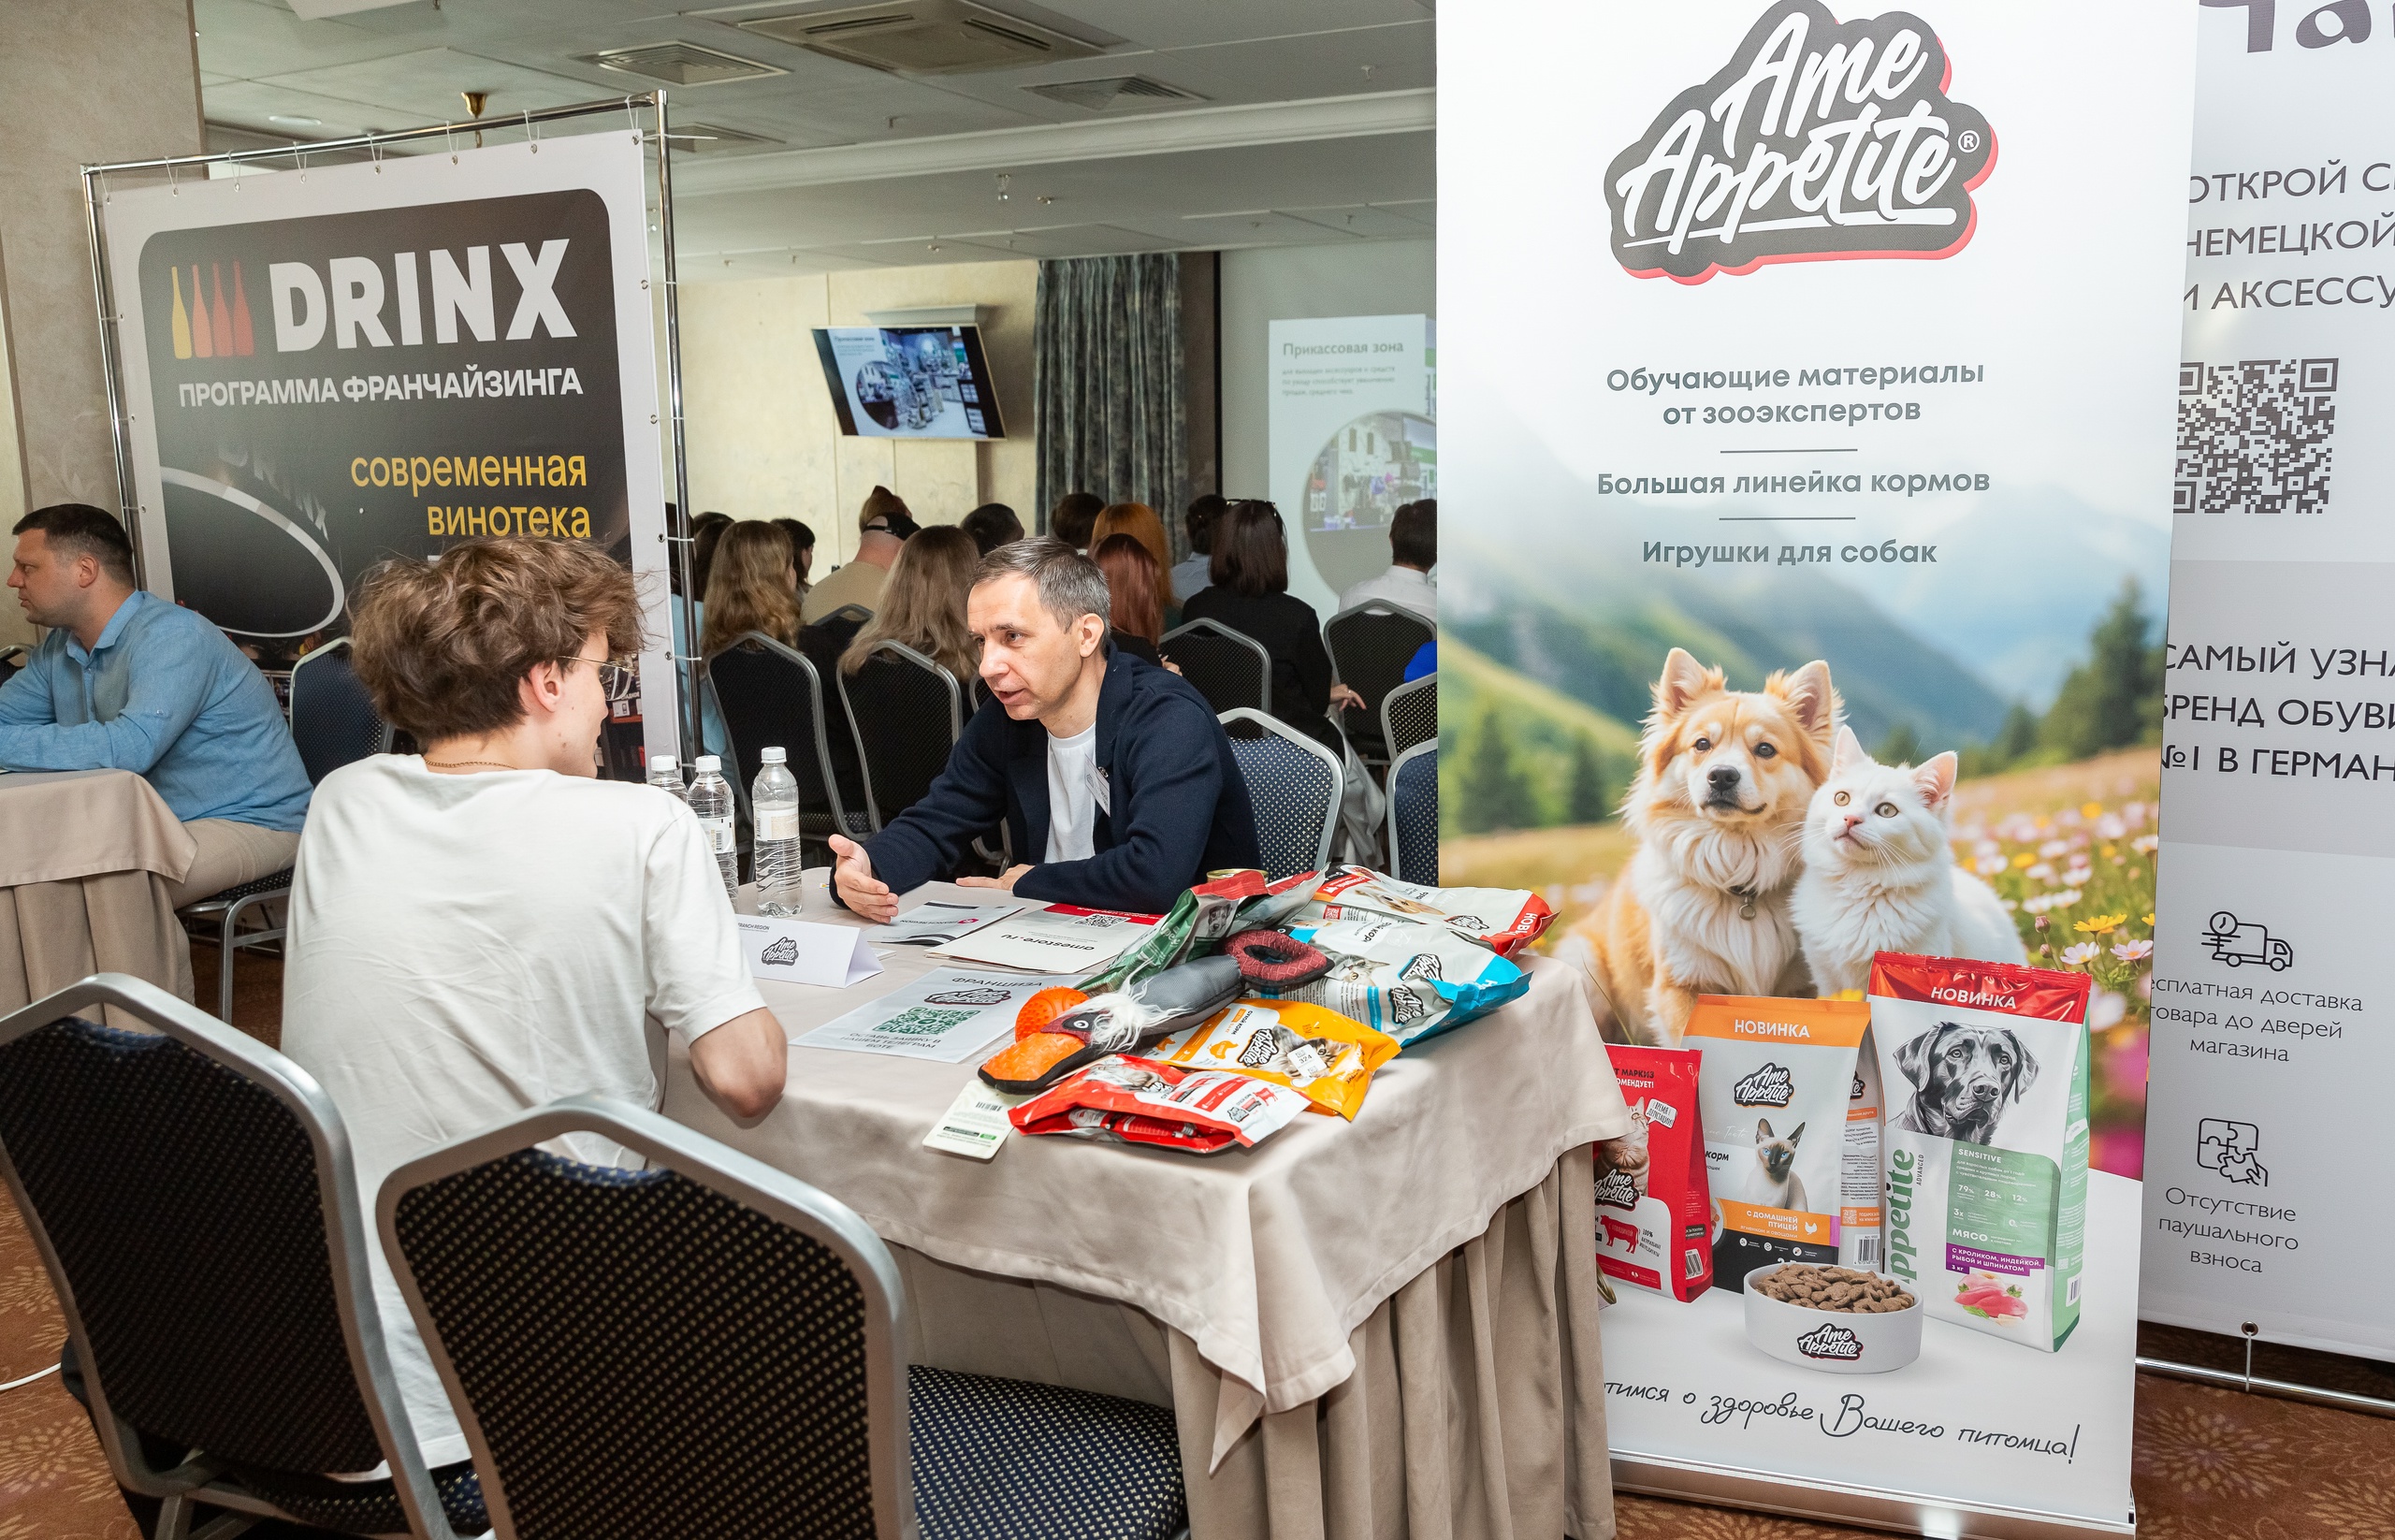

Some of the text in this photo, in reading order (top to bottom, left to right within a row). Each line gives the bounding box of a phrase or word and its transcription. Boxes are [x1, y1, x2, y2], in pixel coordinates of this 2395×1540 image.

[1710, 11, 1928, 158] Ame
[269, 239, 577, 352] DRINX
[1283, 341, 1404, 359] Прикассовая зона
[179, 364, 584, 408] ПРОГРАММА ФРАНЧАЙЗИНГА
[1606, 364, 1984, 396] Обучающие материалы
[1662, 402, 1921, 427] от зооэкспертов
[351, 455, 587, 497] современная
[1597, 470, 1990, 497] Большая линейка кормов
[428, 505, 591, 538] винотека
[1643, 539, 1937, 568] Игрушки для собак
[2310, 647, 2395, 680] УЗН
[2163, 694, 2265, 728] РЕНД
[2218, 747, 2239, 773] В
[1001, 935, 1096, 951] amestore.ru
[952, 977, 1043, 987] ФРАНШИЗА
[1930, 985, 2017, 1010] НОВИНКА
[2260, 989, 2363, 1012] доставка
[1734, 1019, 1811, 1039] НОВИНКА
[2150, 1006, 2343, 1039] овара до дверей
[1299, 1054, 1312, 1064] 324
[2190, 1039, 2289, 1063] магазина
[1617, 1078, 1654, 1089] ОМЕНДУЕТ!
[1621, 1068, 1654, 1079] МАРКИЗ
[1753, 1065, 1788, 1088] Ame
[1735, 1078, 1789, 1103] Appetite
[1706, 1150, 1729, 1161] корм
[1958, 1148, 2002, 1164] SENSITIVE
[1604, 1169, 1633, 1187] Ame
[1915, 1154, 1924, 1186] ADVANCED
[1593, 1180, 1634, 1203] Appetite
[1958, 1184, 1975, 1194] 79%
[1984, 1189, 2002, 1199] 28%
[2012, 1194, 2028, 1203] 12%
[2165, 1186, 2297, 1223] Отсутствие
[1753, 1211, 1798, 1224] ДОМАШНЕЙ
[1767, 1220, 1798, 1232] ПТИЦЕЙ
[1887, 1149, 1917, 1284] ppetite
[1952, 1228, 1989, 1242] МЯСО
[2158, 1216, 2299, 1251] паушального
[1952, 1255, 1976, 1264] РЫБОЙ
[1983, 1260, 2025, 1272] ШПИНАТОМ
[1958, 1248, 1999, 1262] КРОЛИКОМ,
[2000, 1256, 2041, 1267] ИНДЕЙКОЙ,
[2190, 1249, 2262, 1273] взноса
[1799, 1335, 1857, 1355] Appetite
[1815, 1325, 1852, 1344] Ame
[1603, 1381, 2081, 1465] тимся о здоровье Вашего питомца!
